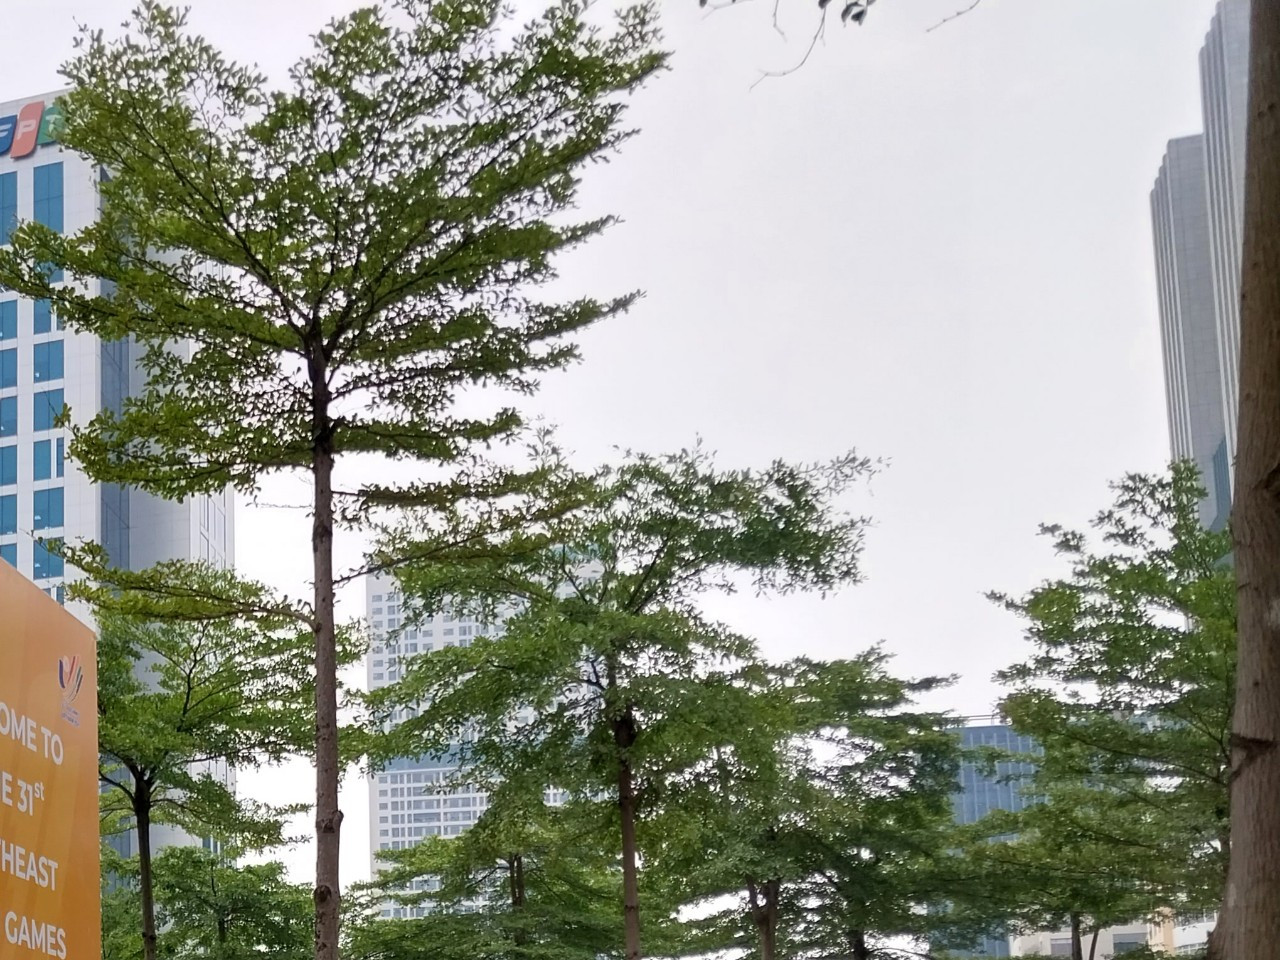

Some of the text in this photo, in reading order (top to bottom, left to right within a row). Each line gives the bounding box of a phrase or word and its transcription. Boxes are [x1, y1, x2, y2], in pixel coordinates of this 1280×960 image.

[41, 726, 64, 765] TO
[17, 779, 45, 817] 31st
[4, 910, 67, 960] GAMES
